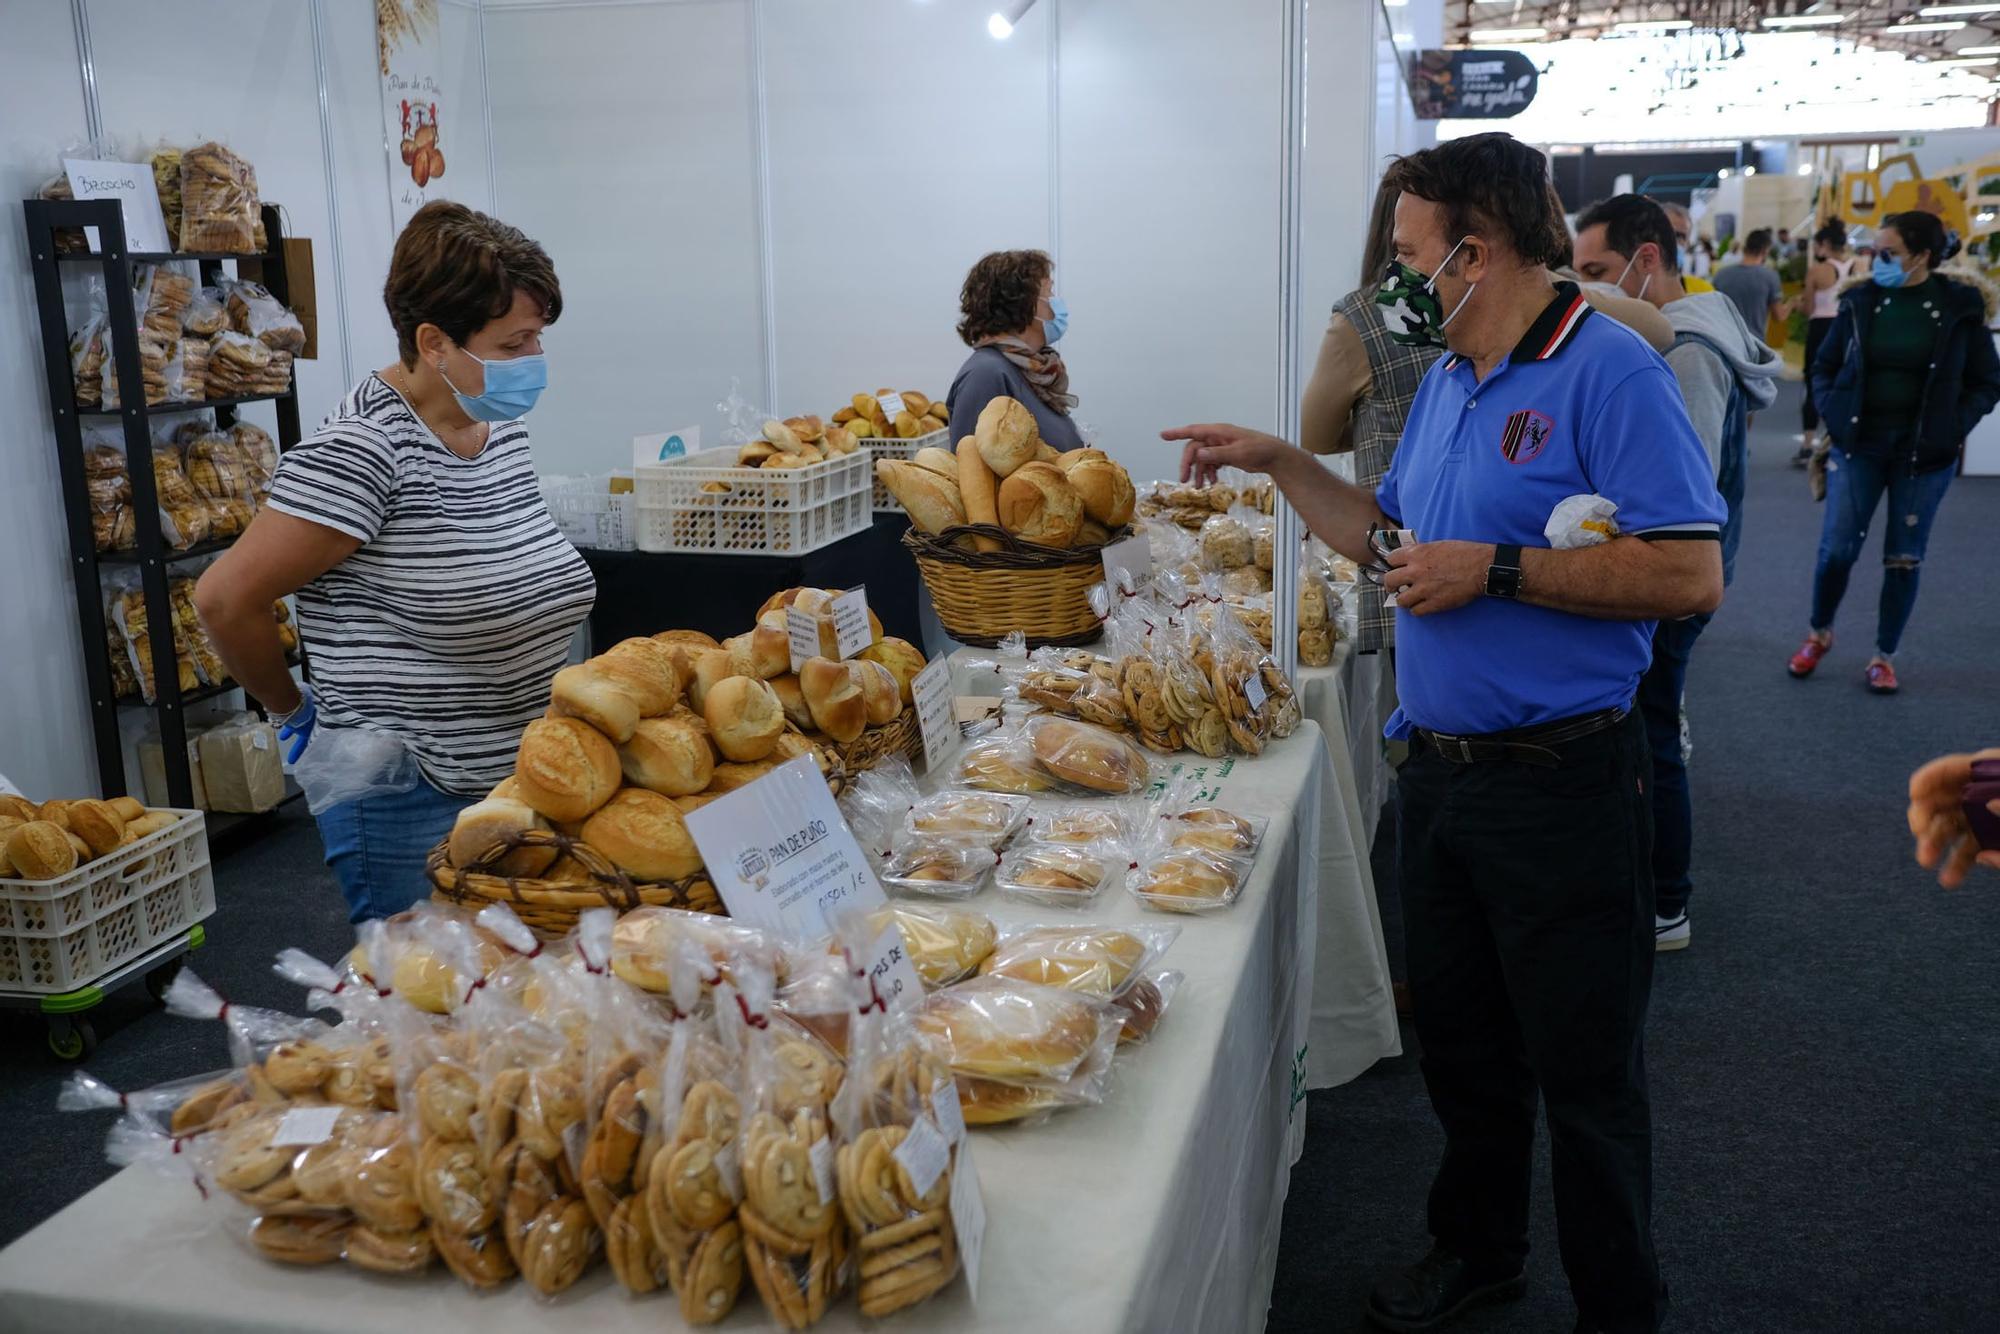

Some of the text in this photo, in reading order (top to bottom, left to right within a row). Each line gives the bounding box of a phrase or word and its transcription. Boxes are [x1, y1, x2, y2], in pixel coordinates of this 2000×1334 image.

[768, 842, 790, 864] PAN
[786, 834, 802, 852] DE
[799, 820, 828, 845] PUÑO
[888, 946, 902, 964] DE
